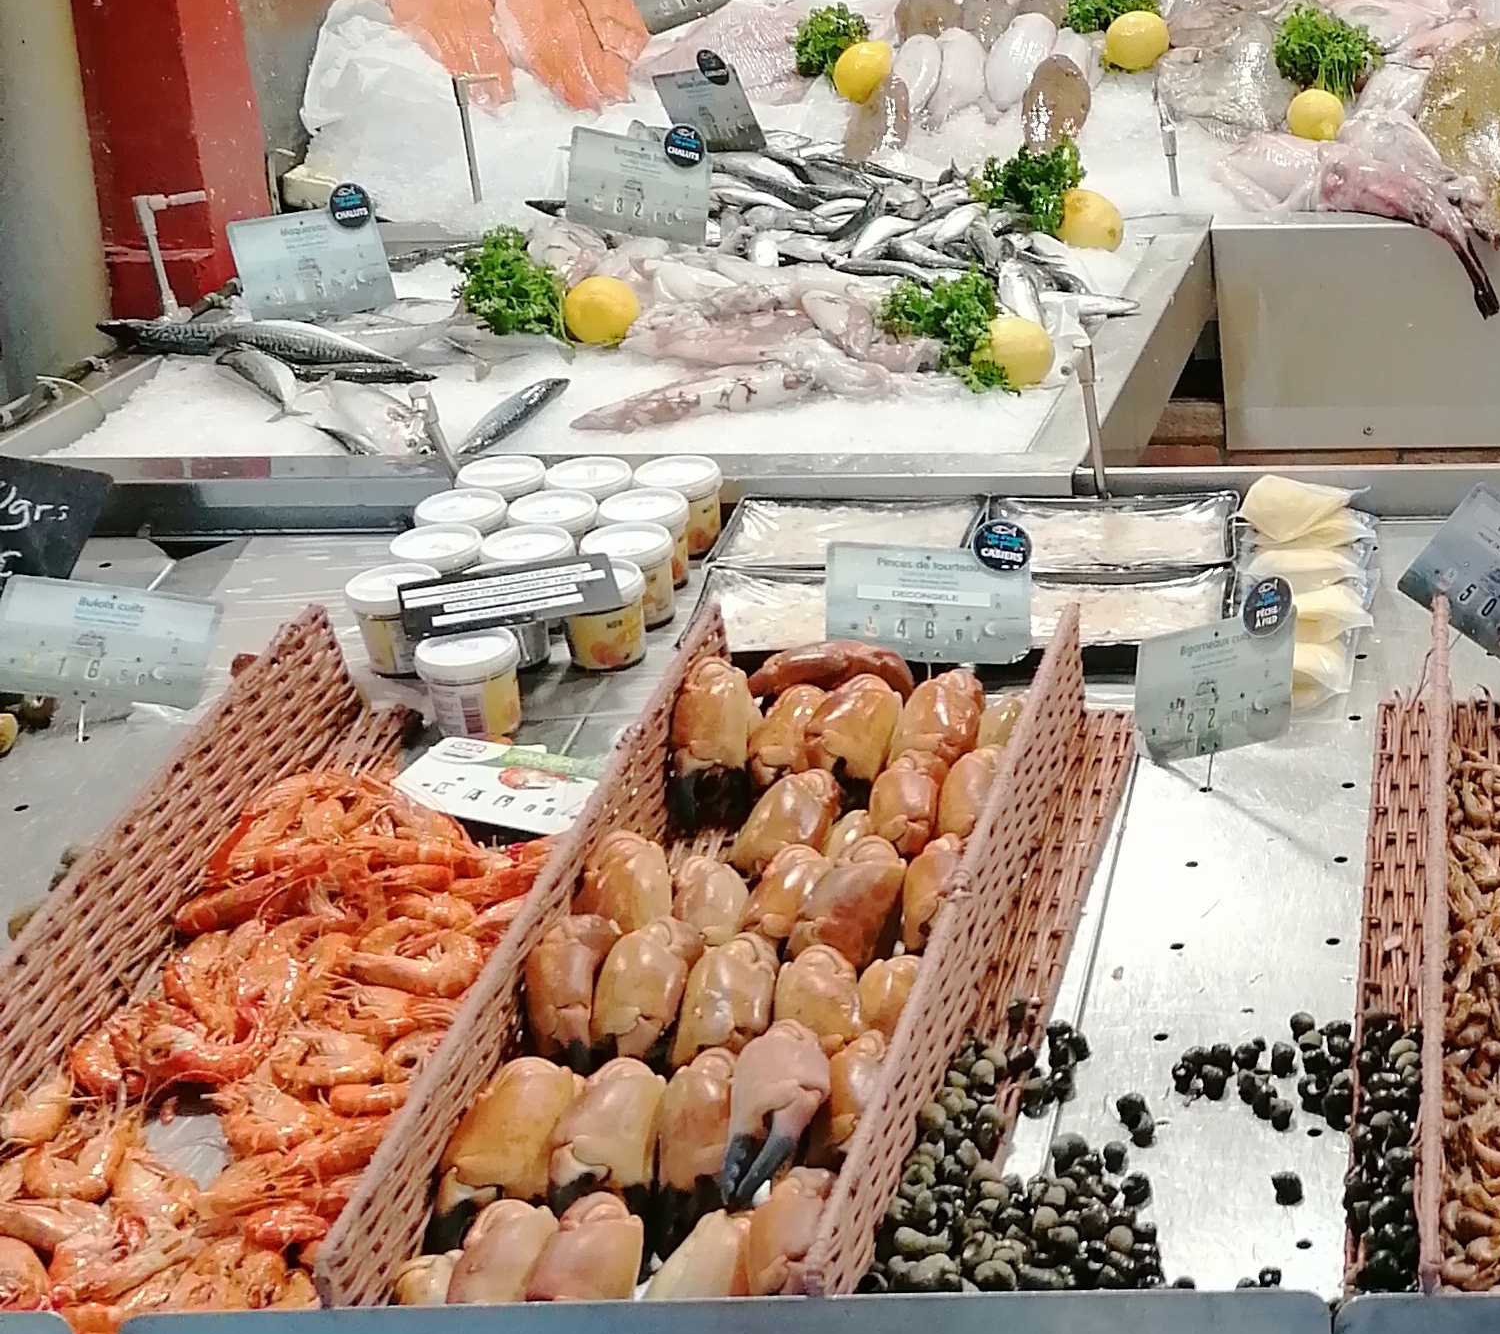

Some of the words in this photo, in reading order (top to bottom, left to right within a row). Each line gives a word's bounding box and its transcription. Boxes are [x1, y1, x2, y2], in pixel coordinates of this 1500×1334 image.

[667, 145, 700, 161] CHALUTS
[335, 207, 369, 221] CHALUTS
[877, 556, 914, 572] Pinces
[916, 558, 931, 571] de
[78, 596, 116, 610] Bulots
[1459, 583, 1498, 618] 50
